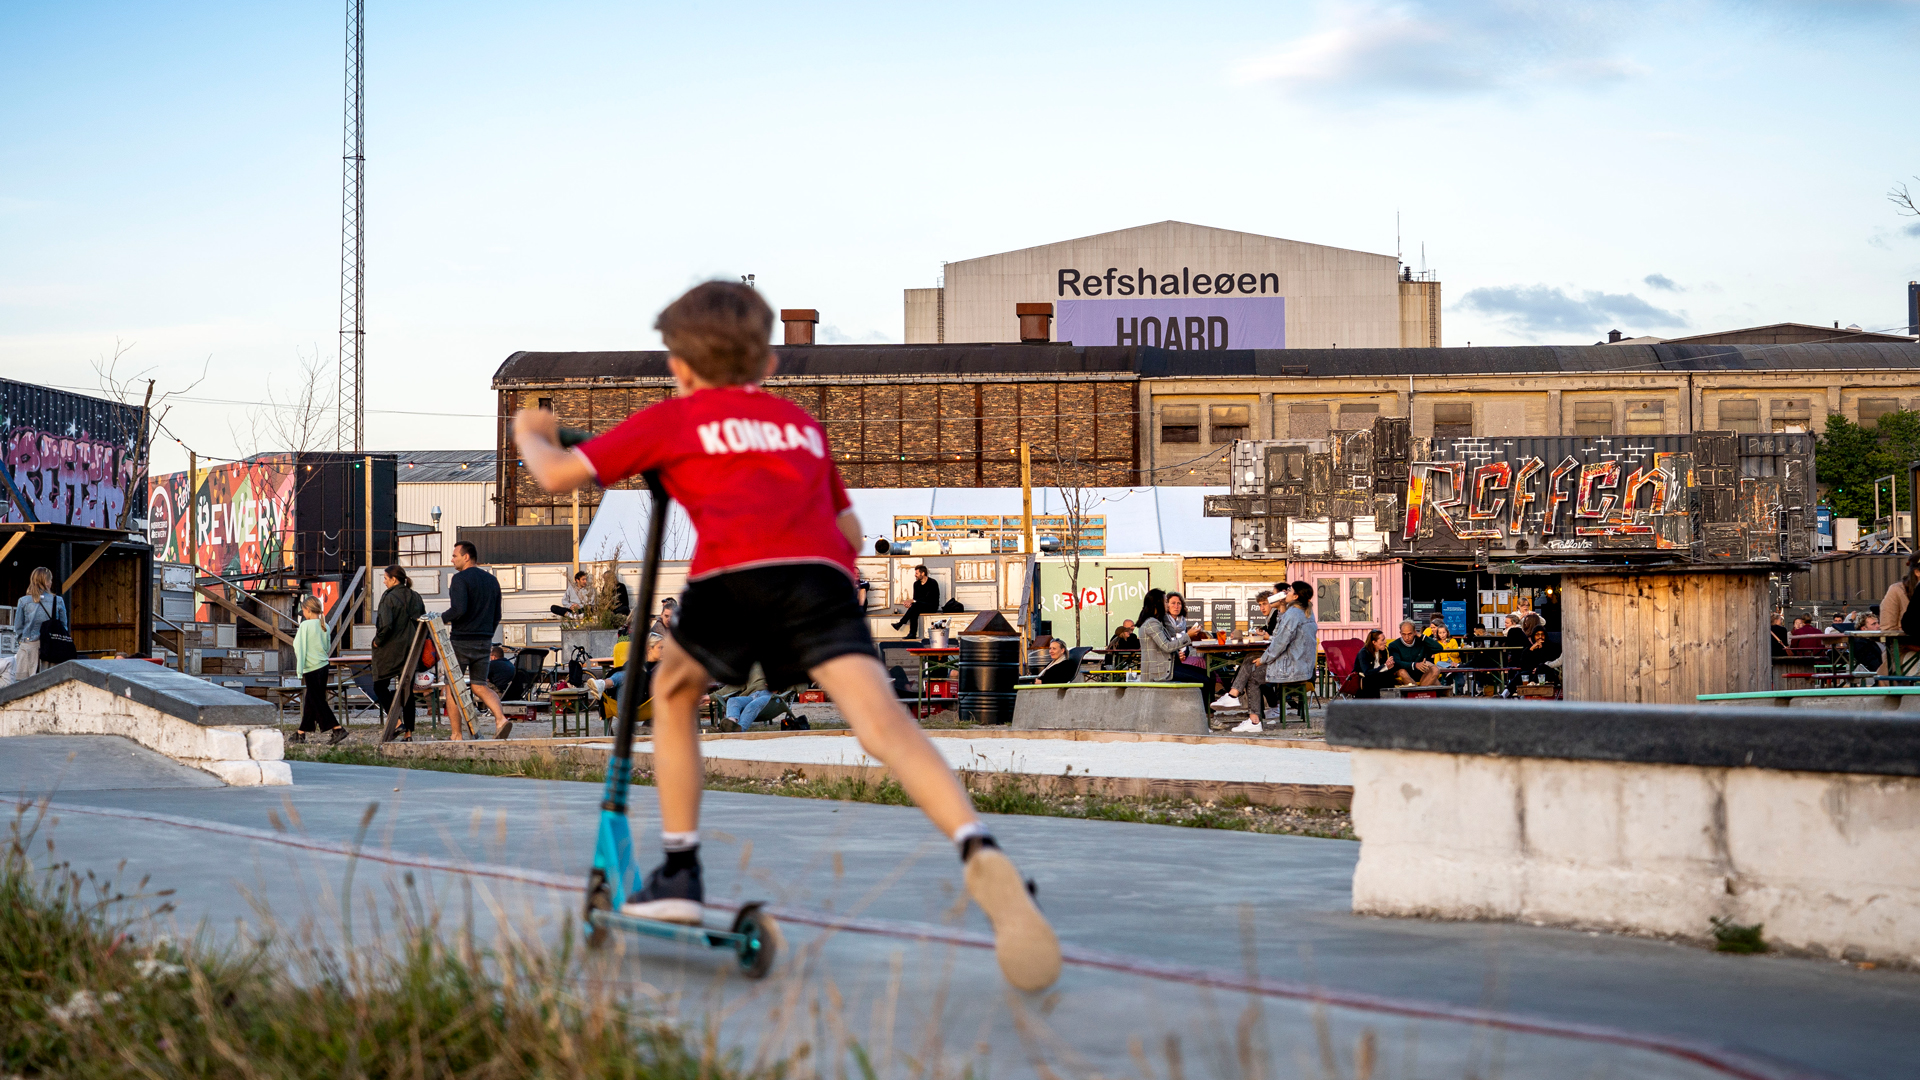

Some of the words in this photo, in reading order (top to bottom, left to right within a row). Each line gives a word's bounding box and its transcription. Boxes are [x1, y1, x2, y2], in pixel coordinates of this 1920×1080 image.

[1058, 267, 1279, 297] Refshaleøen
[1116, 316, 1229, 351] HOARD
[697, 417, 826, 459] KONRAD
